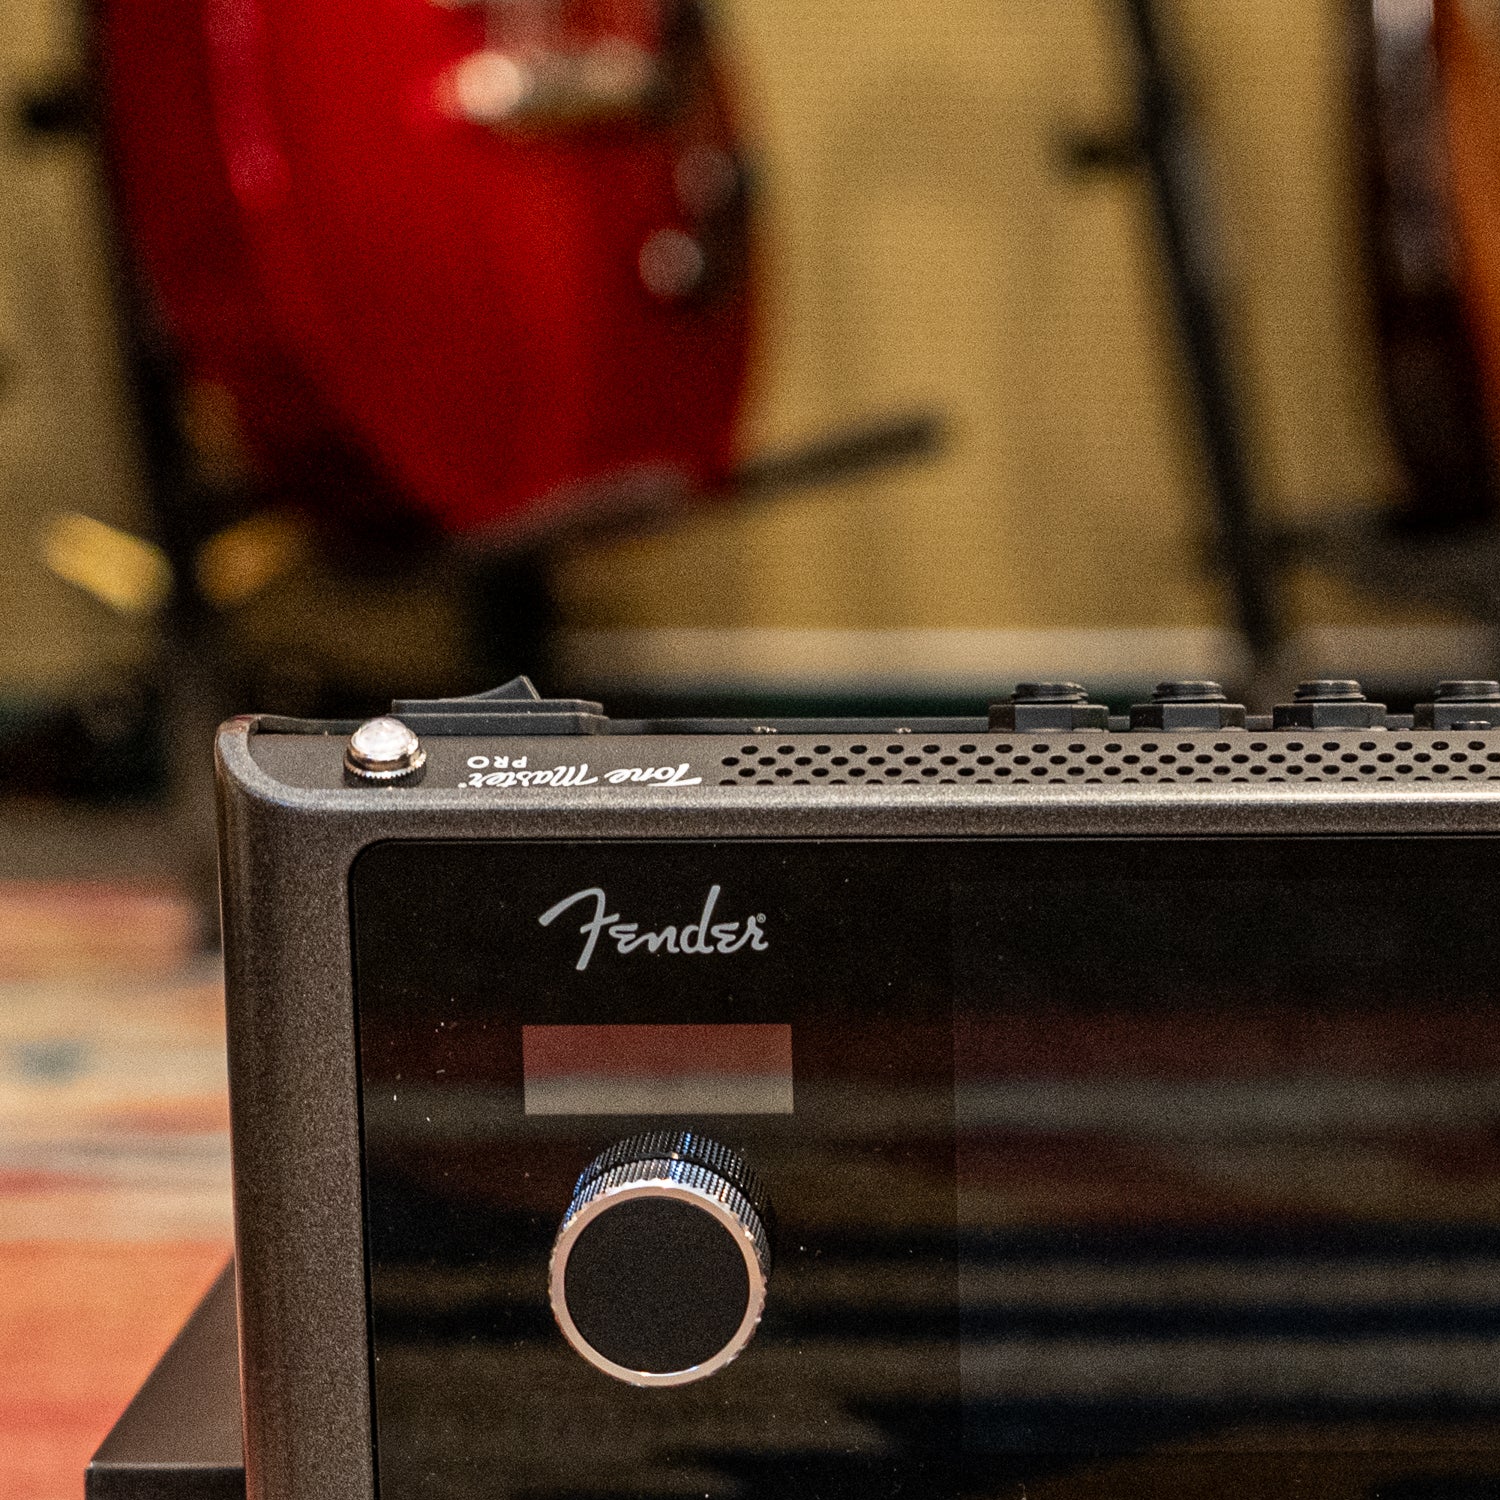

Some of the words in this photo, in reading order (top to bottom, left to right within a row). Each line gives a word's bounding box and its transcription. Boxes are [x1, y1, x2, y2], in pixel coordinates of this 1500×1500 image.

[466, 755, 528, 769] PRO
[603, 762, 703, 787] Tone
[468, 763, 599, 788] Master
[538, 884, 769, 972] Fender
